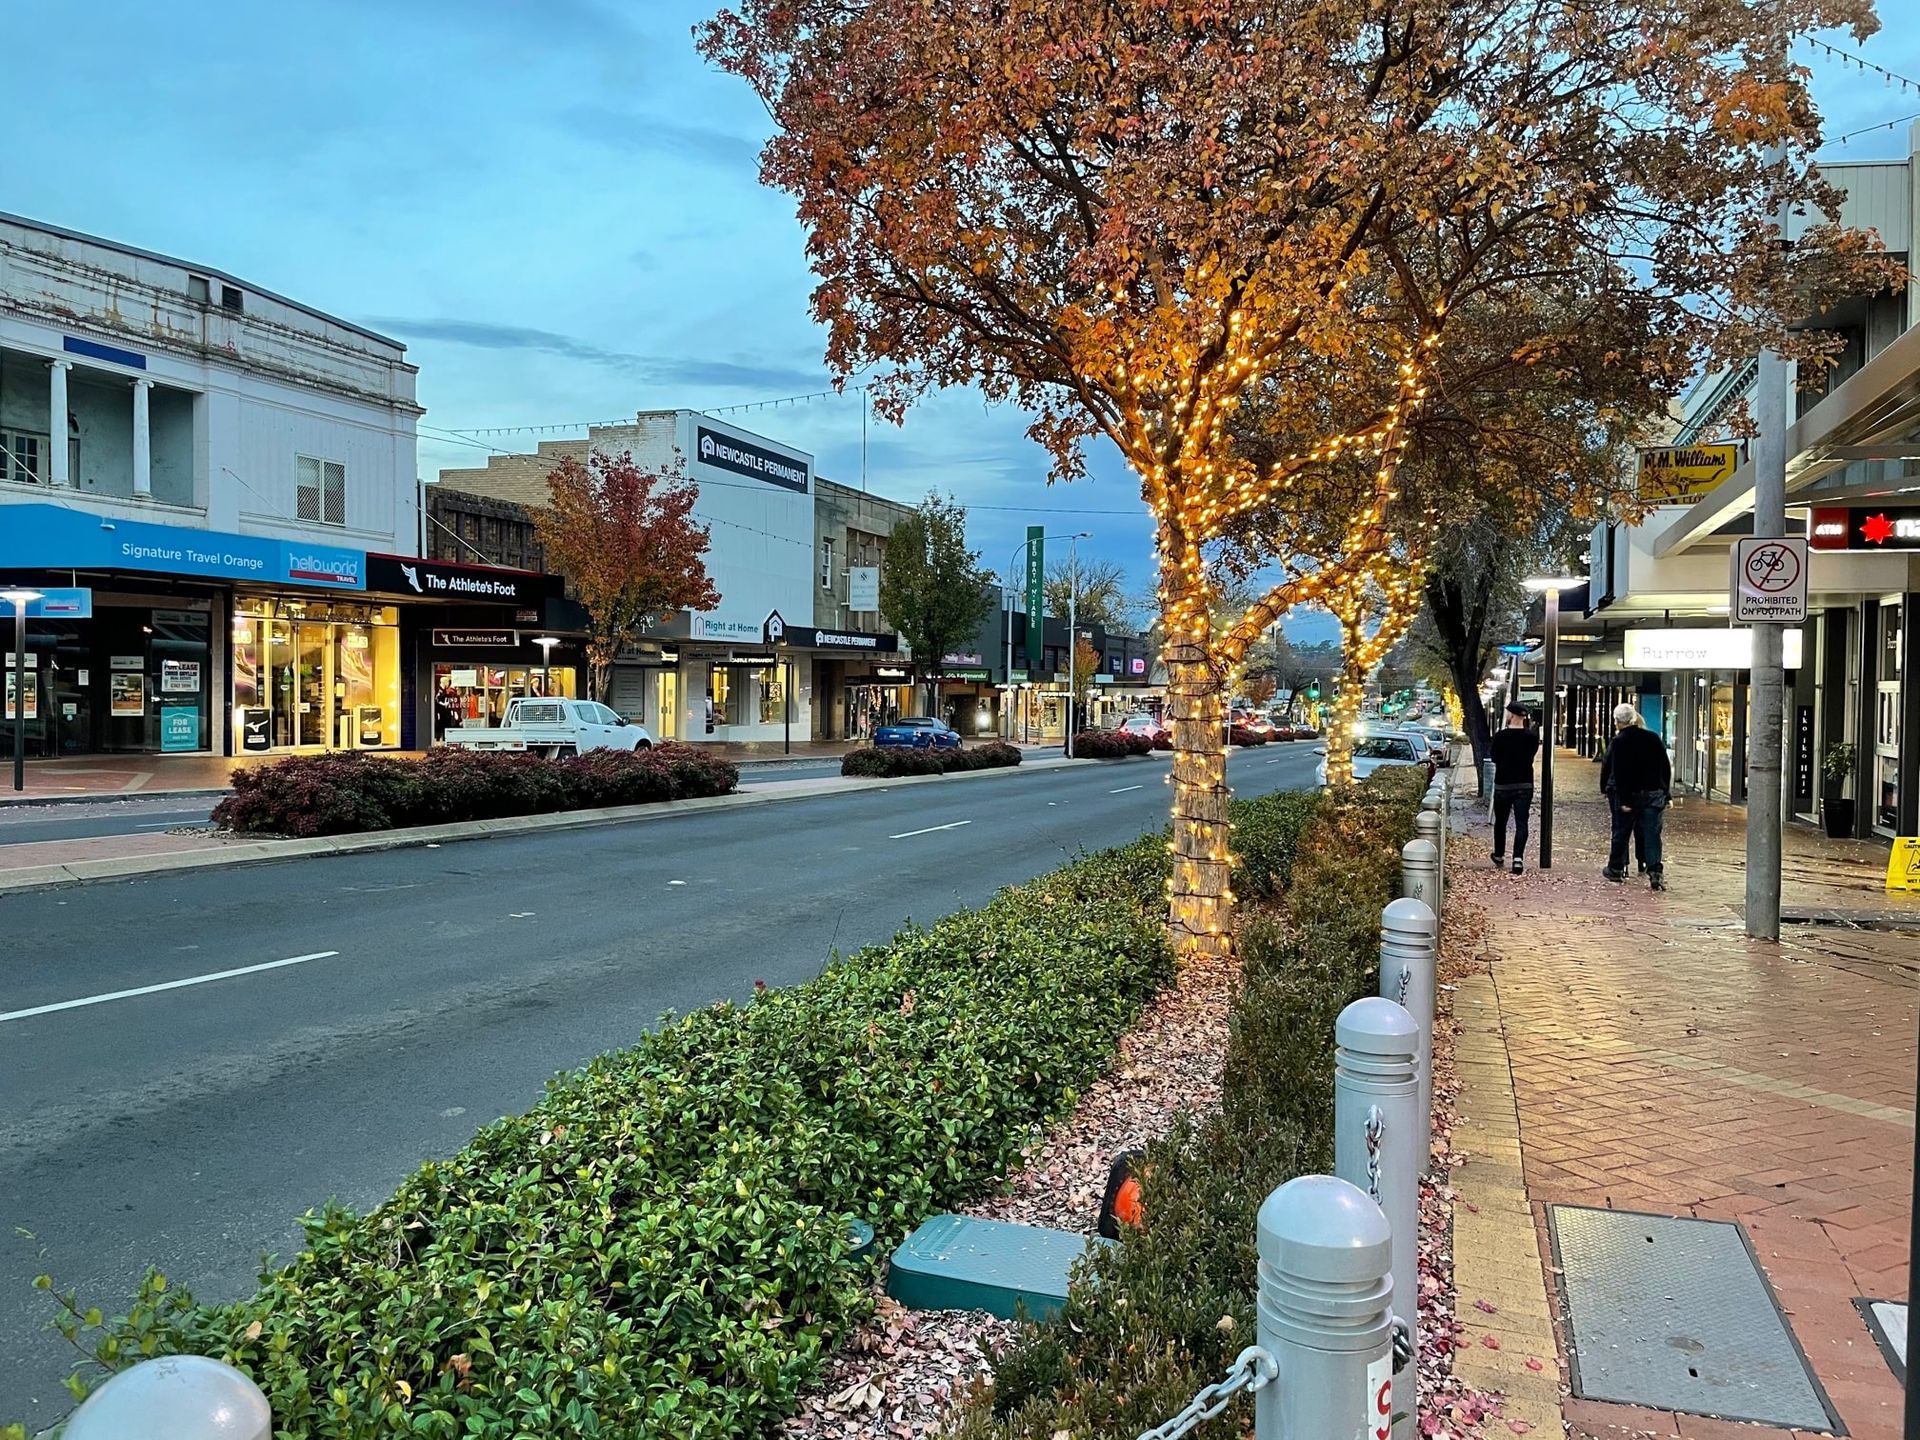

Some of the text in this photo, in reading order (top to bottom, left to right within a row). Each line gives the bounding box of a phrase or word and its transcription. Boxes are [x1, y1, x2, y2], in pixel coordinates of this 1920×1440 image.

[1675, 450, 1726, 467] Williams
[716, 443, 806, 485] NEWCASTLE PERMANENT
[122, 543, 264, 570] Signature Travel Orange
[336, 575, 356, 583] TRAVEL
[425, 573, 516, 596] The Athlete's Foot
[1746, 596, 1798, 605] PROHIBITED
[1741, 607, 1802, 616] ON FOOTPATH
[705, 620, 726, 632] Right
[737, 623, 759, 633] Home
[465, 635, 492, 643] Athlete's
[824, 634, 851, 645] NEWCASTLE
[1642, 647, 1708, 659] Burrow
[179, 663, 199, 671] LEASE
[172, 718, 188, 726] FOR
[168, 726, 192, 734] LEASE
